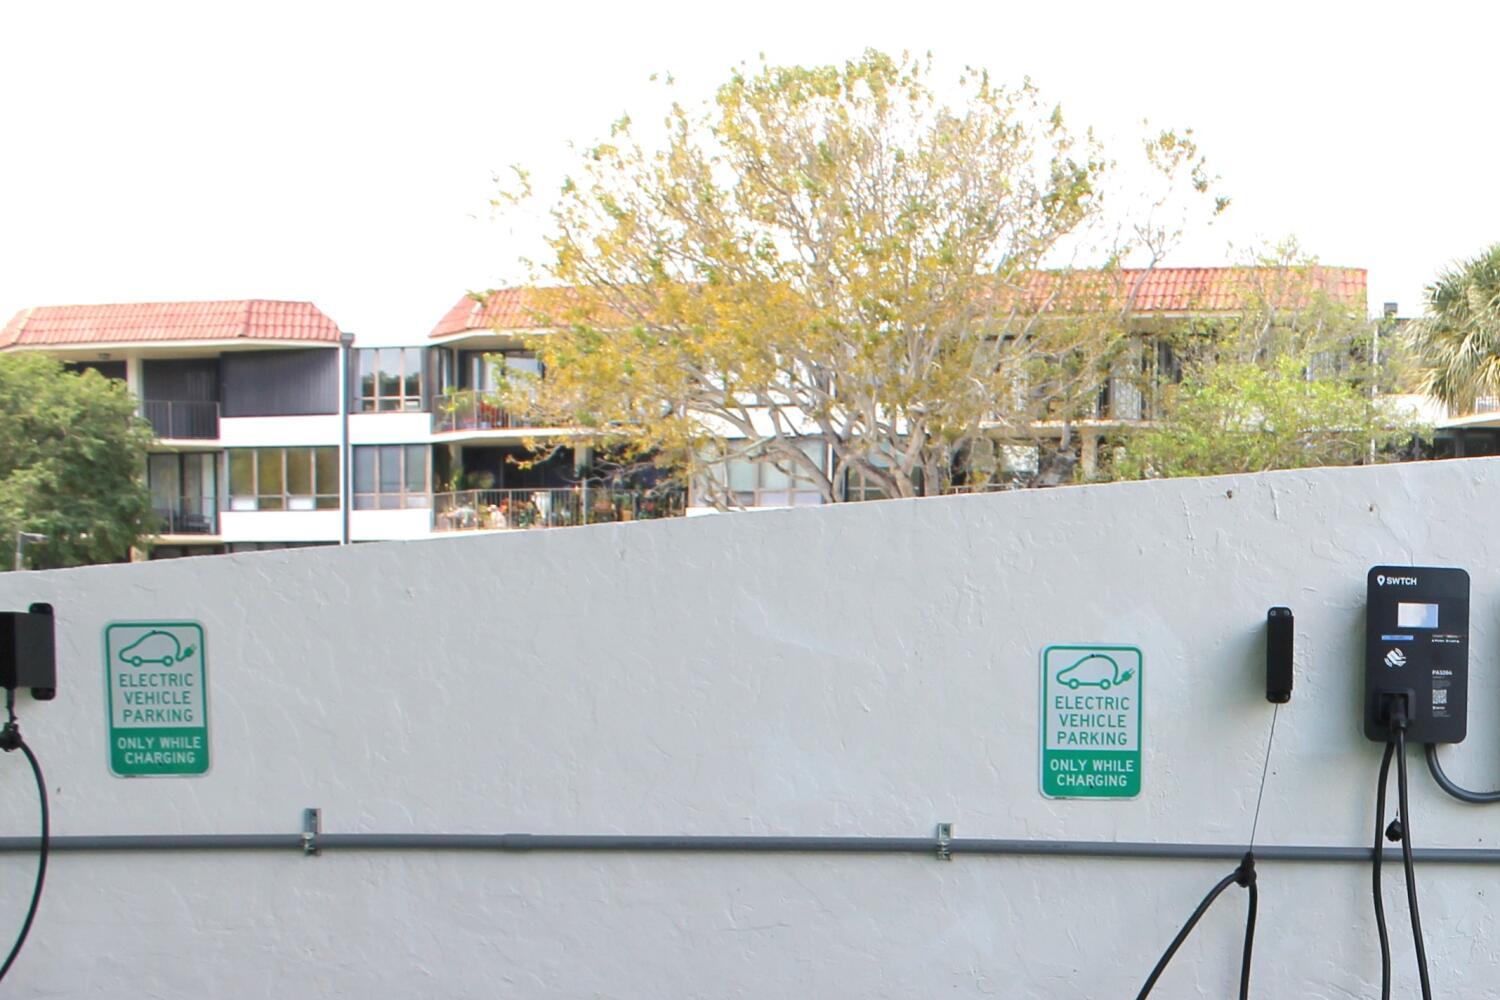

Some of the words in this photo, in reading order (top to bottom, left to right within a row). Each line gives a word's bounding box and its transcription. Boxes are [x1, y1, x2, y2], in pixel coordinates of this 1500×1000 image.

[1386, 576, 1417, 586] SWTCH
[119, 673, 194, 688] ELECTRIC
[123, 690, 191, 705] VEHICLE
[1055, 696, 1130, 711] ELECTRIC
[123, 709, 194, 723] PARKING
[1059, 714, 1126, 728] VEHICLE
[117, 737, 154, 749] ONLY
[159, 736, 201, 749] WHILE
[1057, 731, 1128, 746] PARKING
[125, 751, 196, 764] CHARGING
[1050, 759, 1087, 772] ONLY
[1092, 759, 1134, 772] WHILE
[1057, 773, 1127, 787] CHARGING
